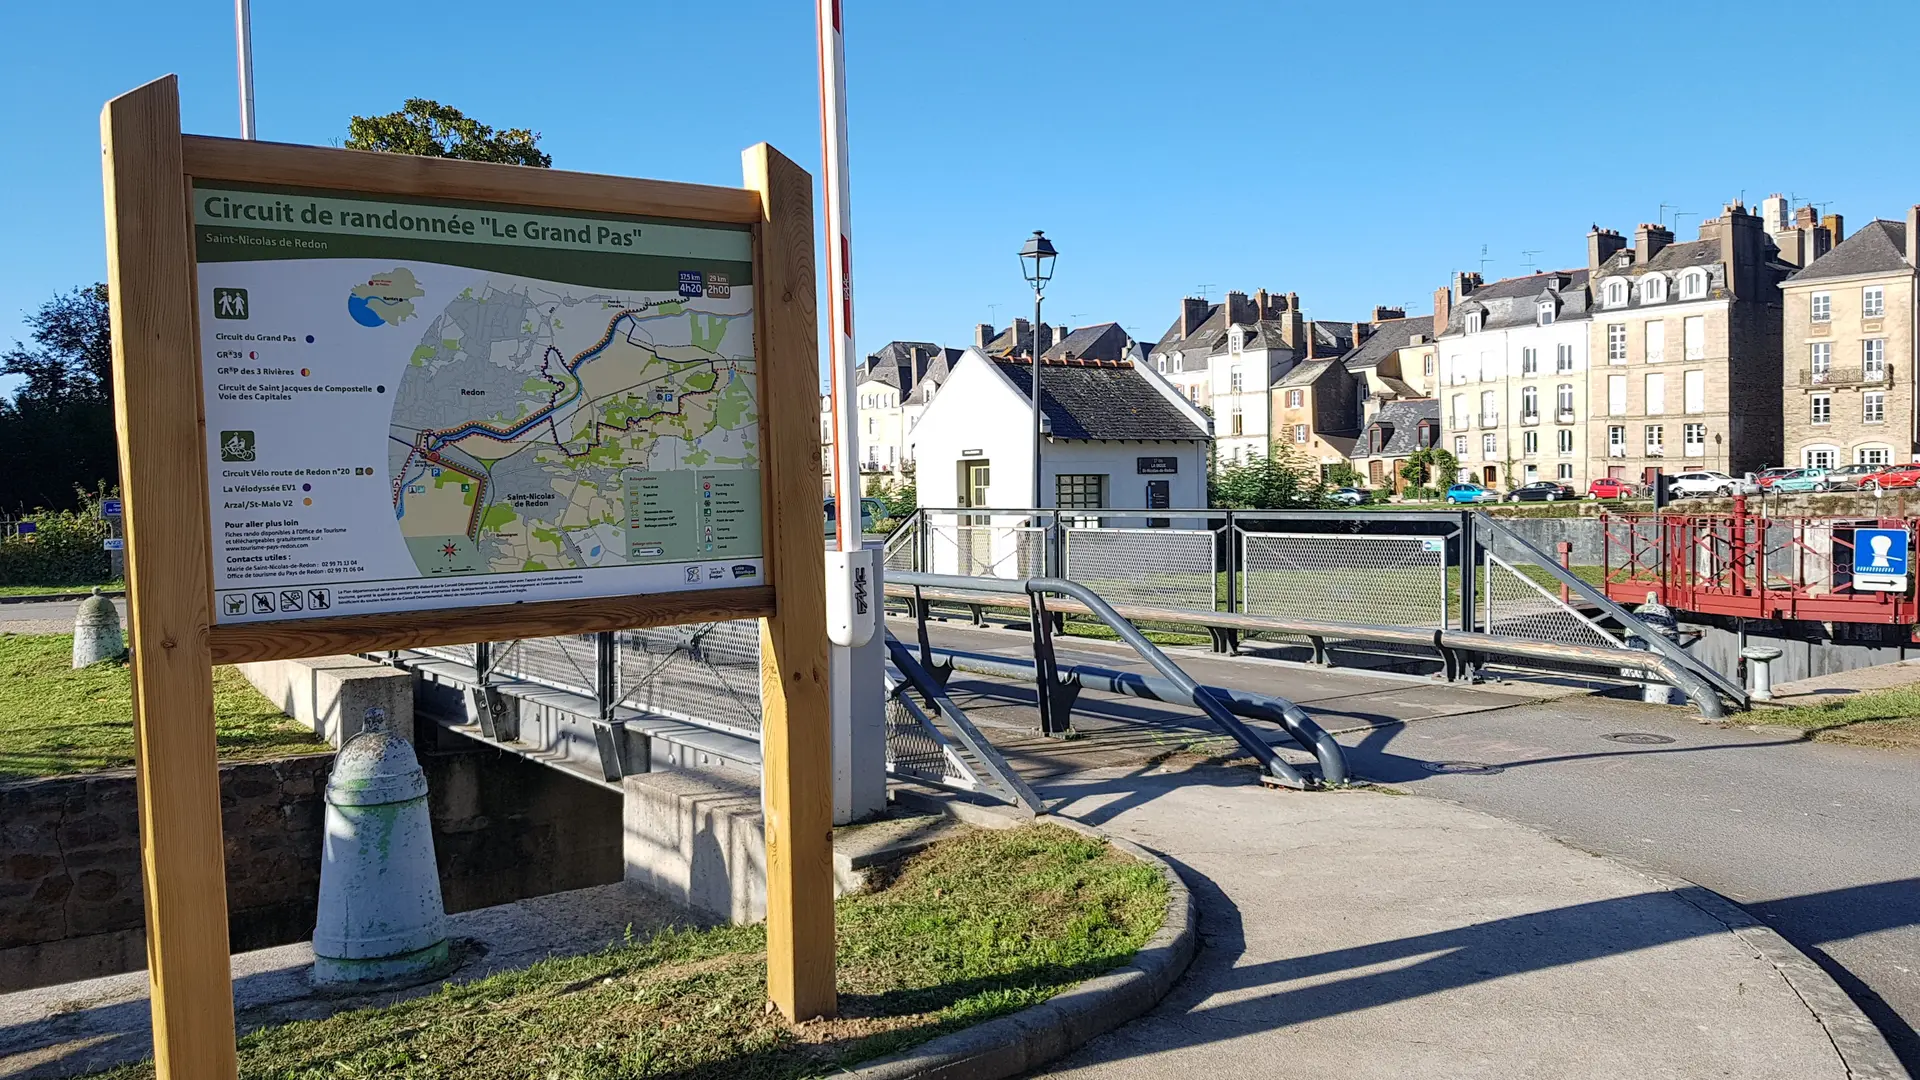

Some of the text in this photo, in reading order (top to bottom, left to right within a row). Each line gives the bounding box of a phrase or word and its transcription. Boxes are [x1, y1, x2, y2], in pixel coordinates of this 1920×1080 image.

[205, 197, 641, 246] Circuit de randonnée "Le Grand Pas"
[206, 233, 328, 249] Saint-Nicolas de Redon
[680, 284, 701, 293] 4h20
[708, 285, 729, 295] 2h00
[326, 386, 372, 394] Compostelle
[266, 520, 282, 528] plus
